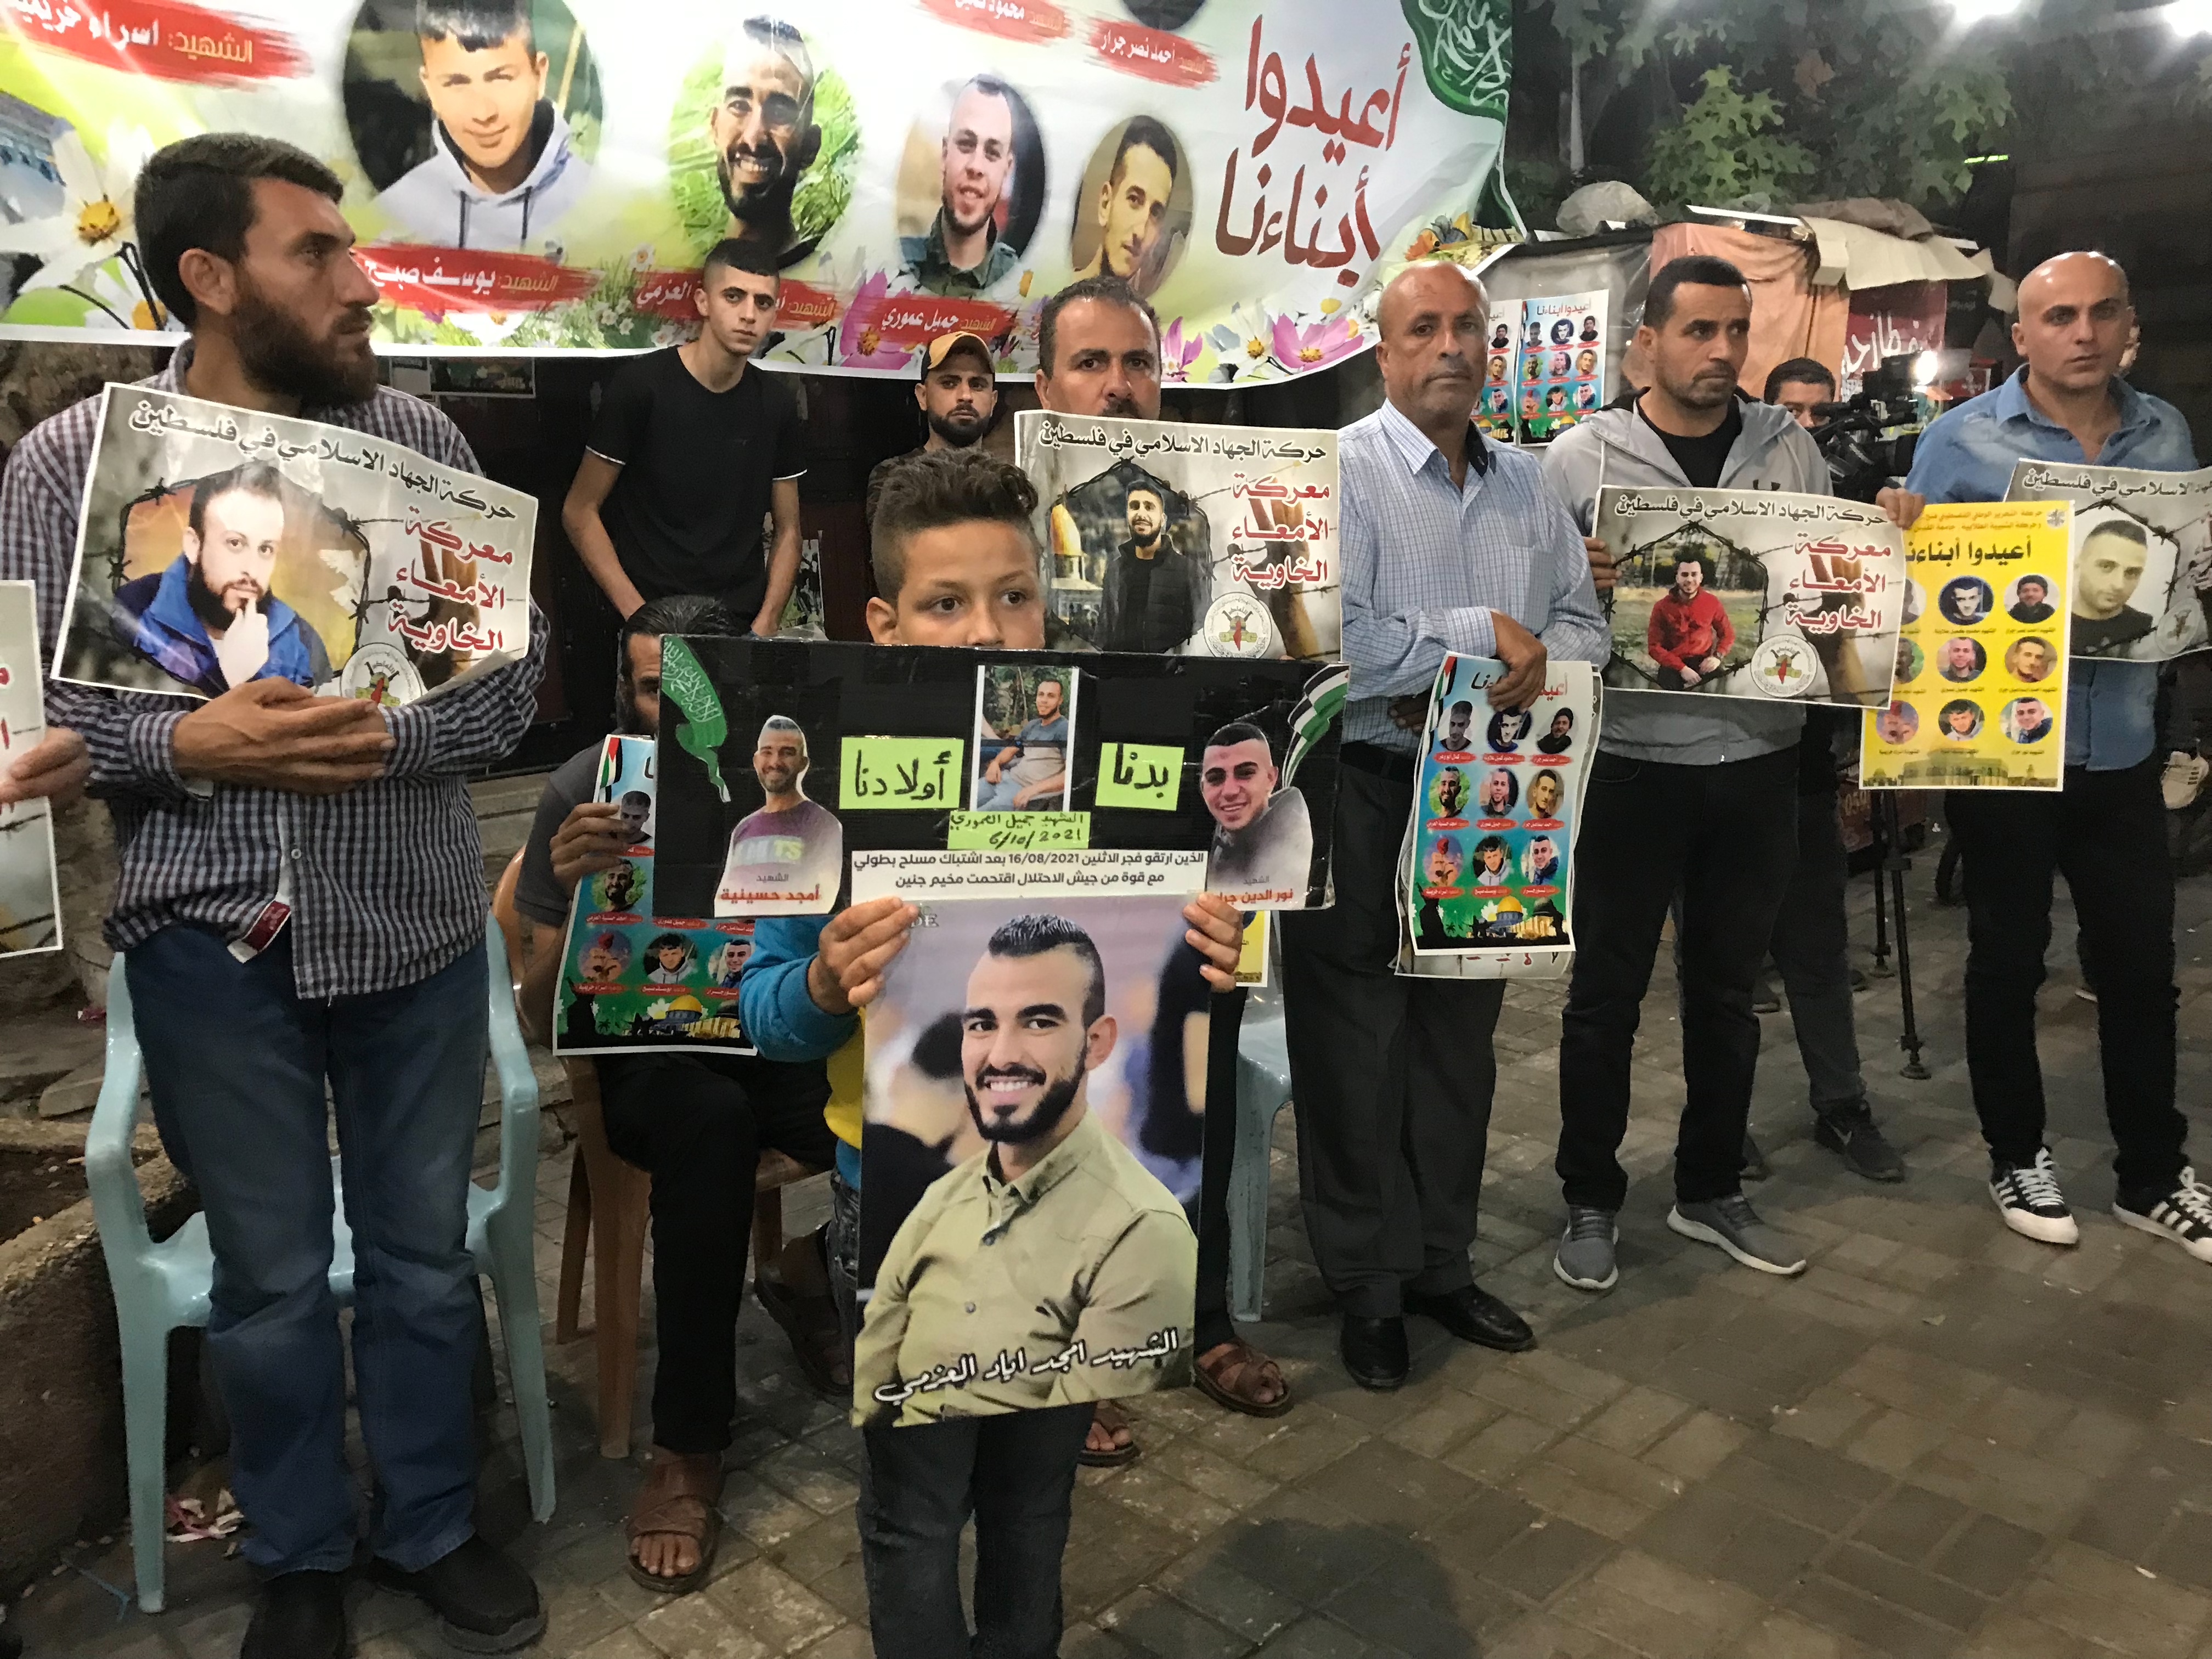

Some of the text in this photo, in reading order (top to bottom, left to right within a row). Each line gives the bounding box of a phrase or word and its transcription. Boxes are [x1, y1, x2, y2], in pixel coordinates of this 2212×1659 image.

[1245, 14, 1411, 167] أعيدوا
[1215, 148, 1381, 288] أبناءنا
[422, 257, 496, 295] يوسف
[636, 279, 693, 308] العزمي
[882, 308, 924, 331] عموري
[924, 308, 958, 333] جميل
[1041, 421, 1327, 462] حركة الجهاد الاسلامي في فلسطين
[132, 403, 516, 518] حركة الجهاد الاسلامي في فلسطين
[1233, 473, 1330, 505] معركة
[2024, 469, 2091, 490] فلسطين
[2092, 476, 2118, 497] في
[1233, 511, 1328, 540] الأمعاء
[1616, 494, 1887, 526] حركة الجهاد الاسلامي في فلسطين
[405, 506, 512, 565] معركة
[1795, 533, 1891, 560] معركة
[1905, 535, 2032, 567] أعيدوا أبناءن
[396, 558, 504, 610] الأمعاء
[1231, 556, 1328, 589] الخاوية
[1790, 568, 1886, 594] الأمعاء
[388, 602, 503, 651] الخاوية
[1785, 602, 1882, 633] الخاوية
[855, 742, 1169, 800] بدنا أولادنا
[1006, 814, 1035, 829] جميل
[1041, 812, 1084, 827] الشهيد
[854, 850, 1204, 871] الذين ارتقو فجر الاثنين 16/08/2021 بعد اشتباك مسلح بطولي
[720, 883, 820, 904] أمجد حسينية
[895, 870, 1165, 888] مع قوة من جيش الاحتلال اقتحمت مخيم جنين
[1217, 888, 1294, 905] نور الدين جرا
[874, 1327, 1179, 1407] الشهيد امجد اياد العزمي
